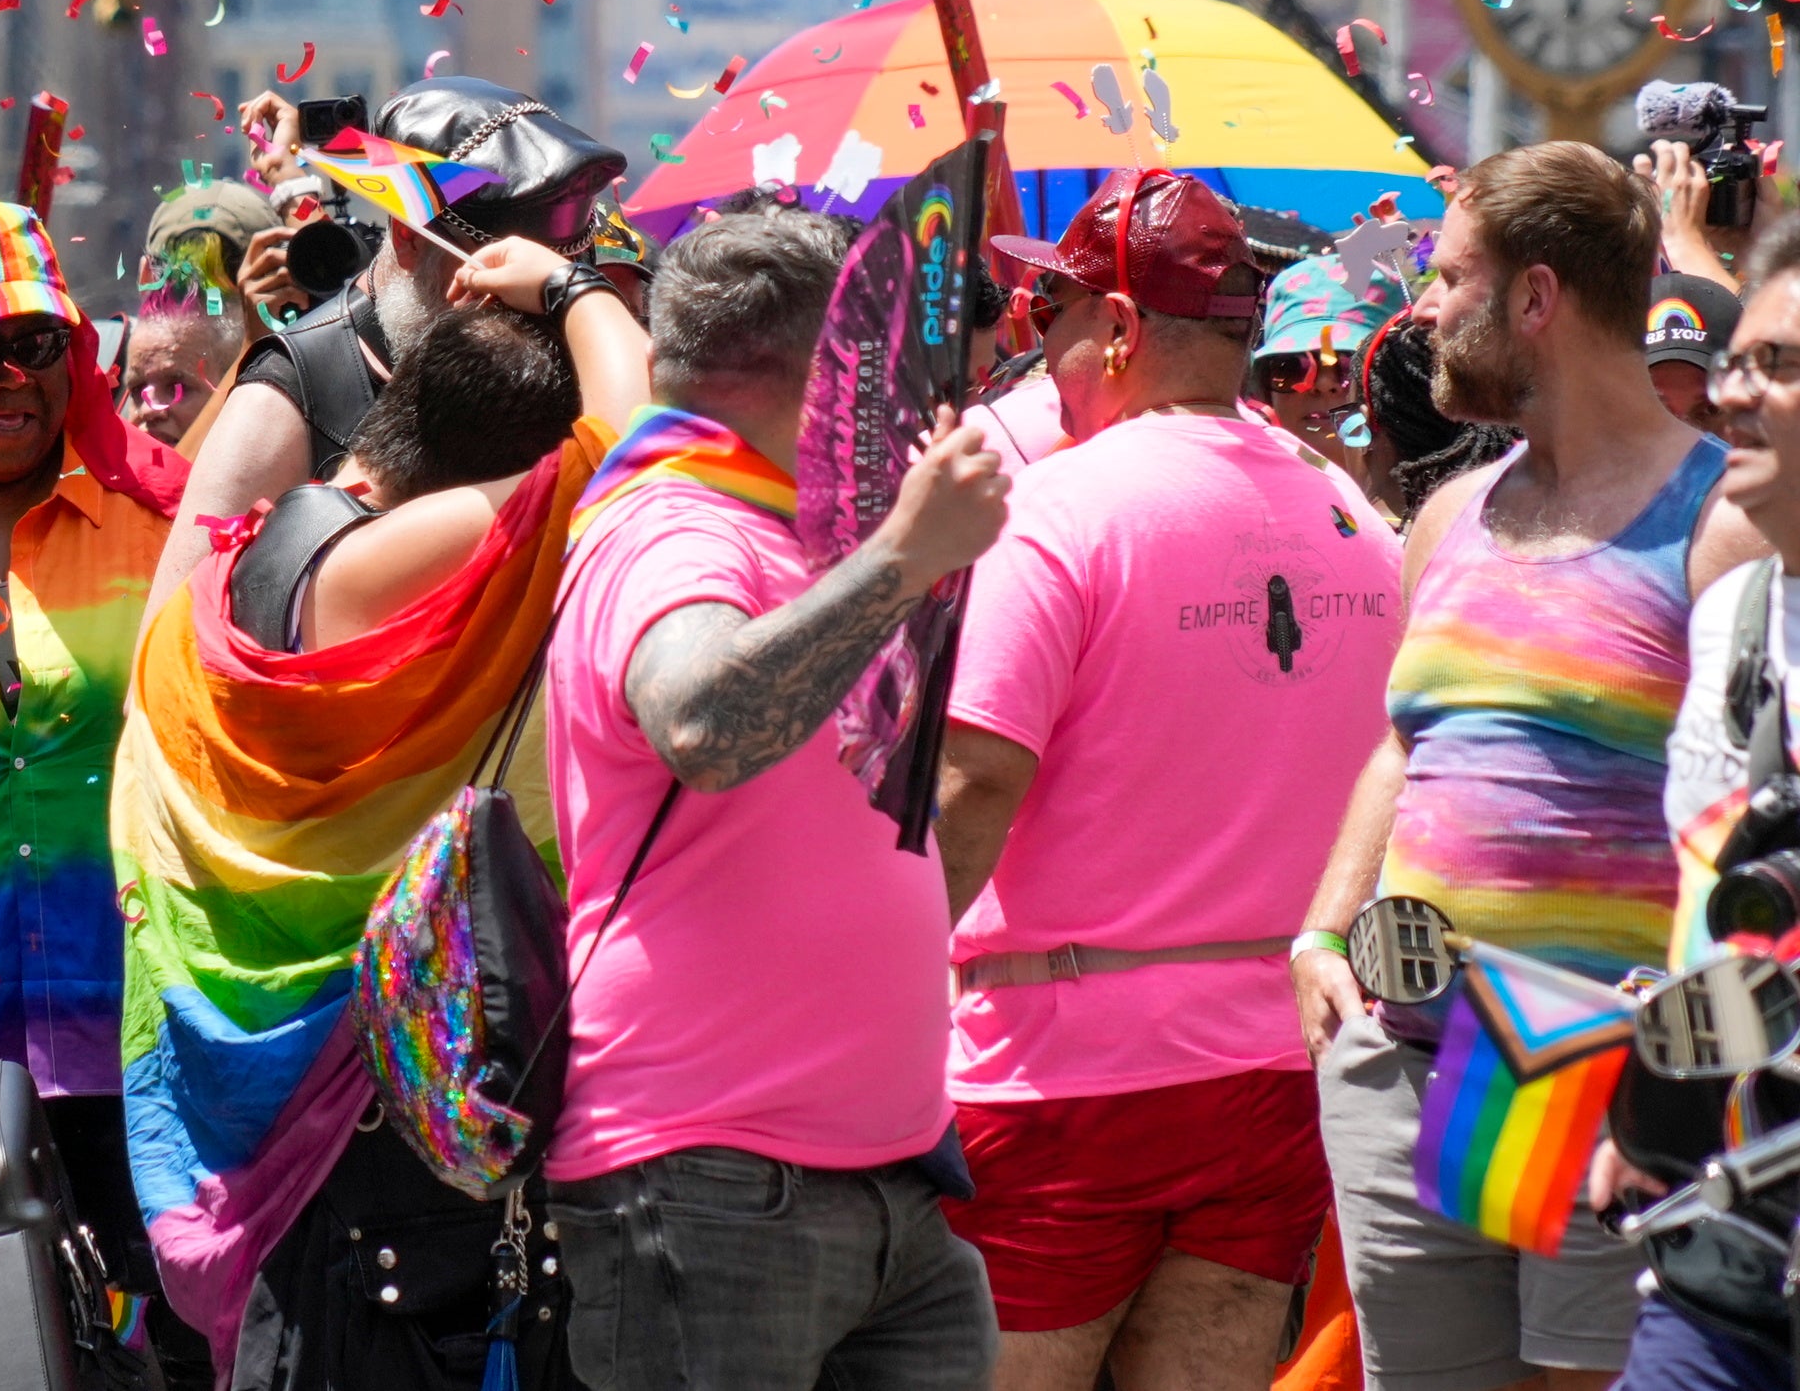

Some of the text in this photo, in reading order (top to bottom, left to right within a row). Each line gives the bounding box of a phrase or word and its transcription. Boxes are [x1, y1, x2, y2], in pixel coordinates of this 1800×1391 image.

[919, 235, 946, 345] pride
[1645, 328, 1707, 345] BE YOU
[1179, 593, 1386, 630] EMPIRE CITY MC
